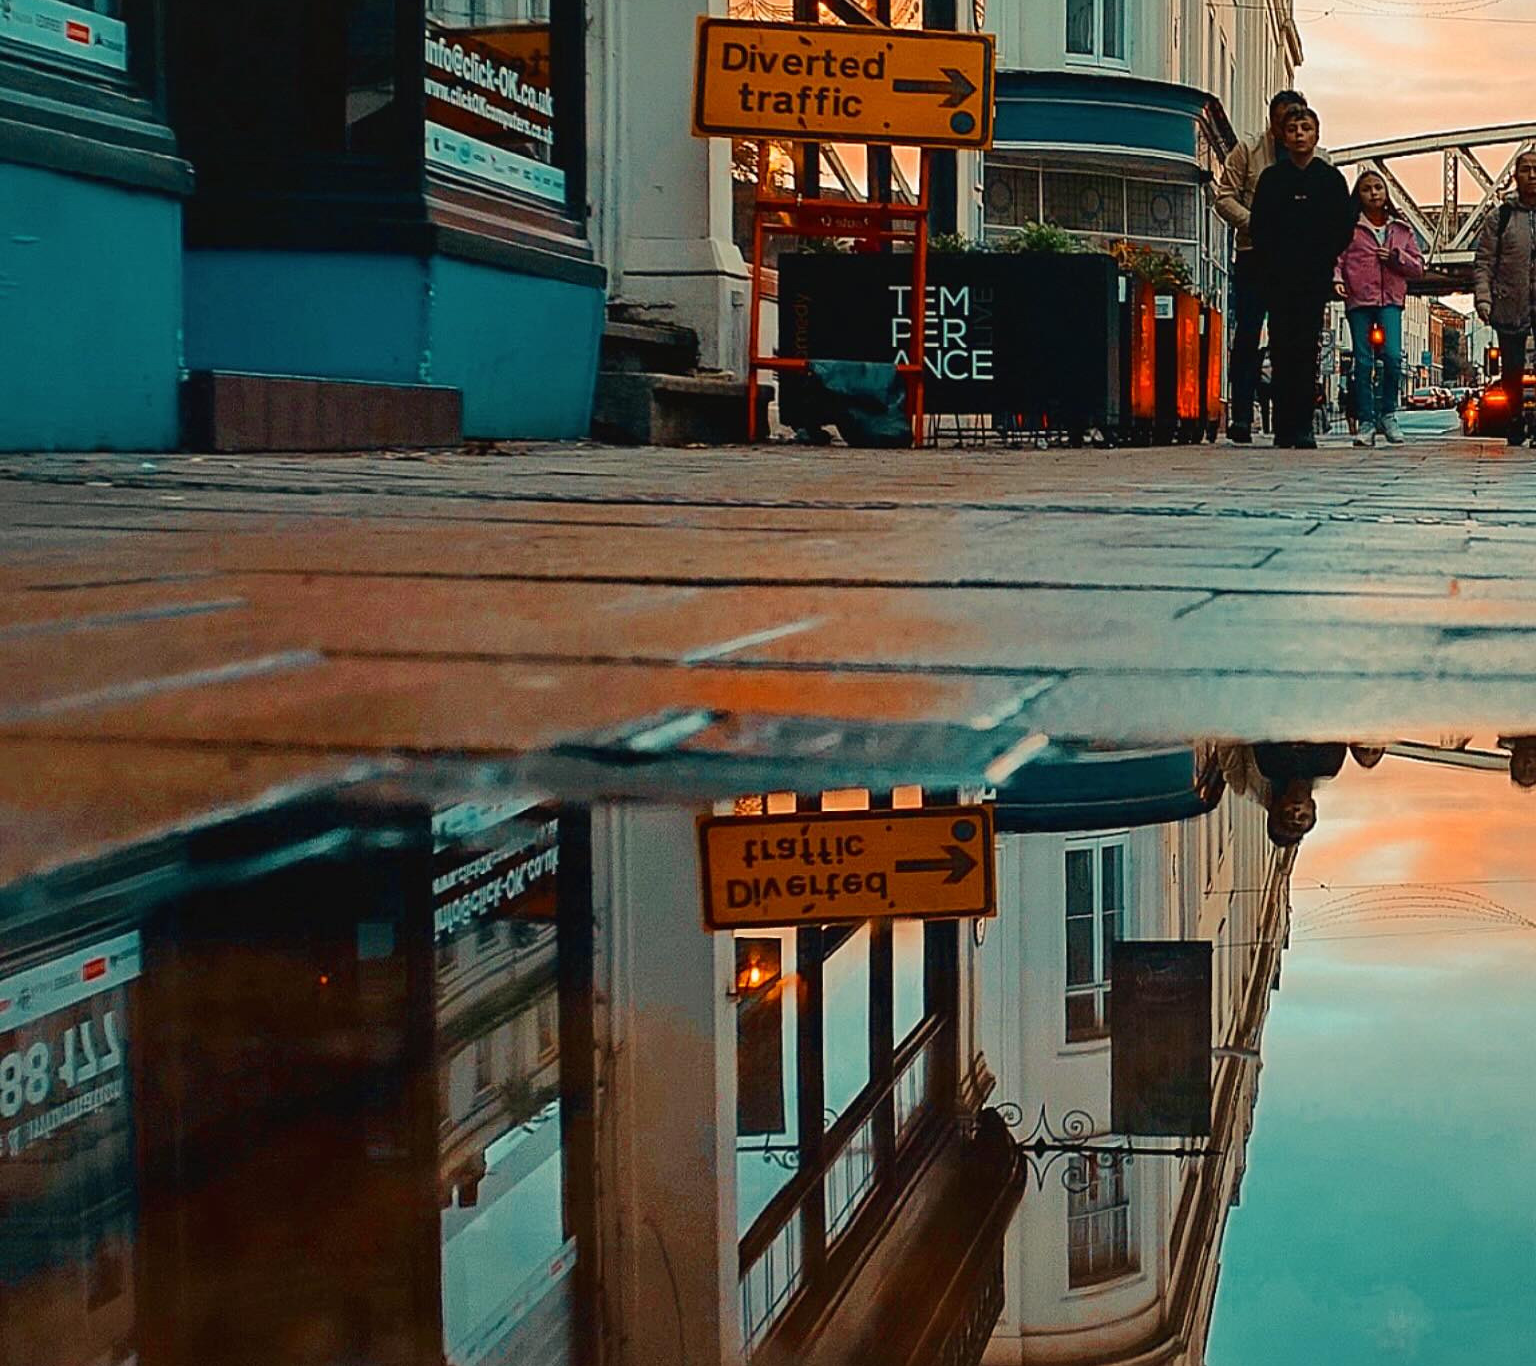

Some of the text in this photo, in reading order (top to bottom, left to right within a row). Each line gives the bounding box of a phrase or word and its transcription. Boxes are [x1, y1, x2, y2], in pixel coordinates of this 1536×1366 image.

[721, 41, 886, 81] Diverted
[738, 82, 864, 119] traffic
[888, 285, 970, 316] TEM
